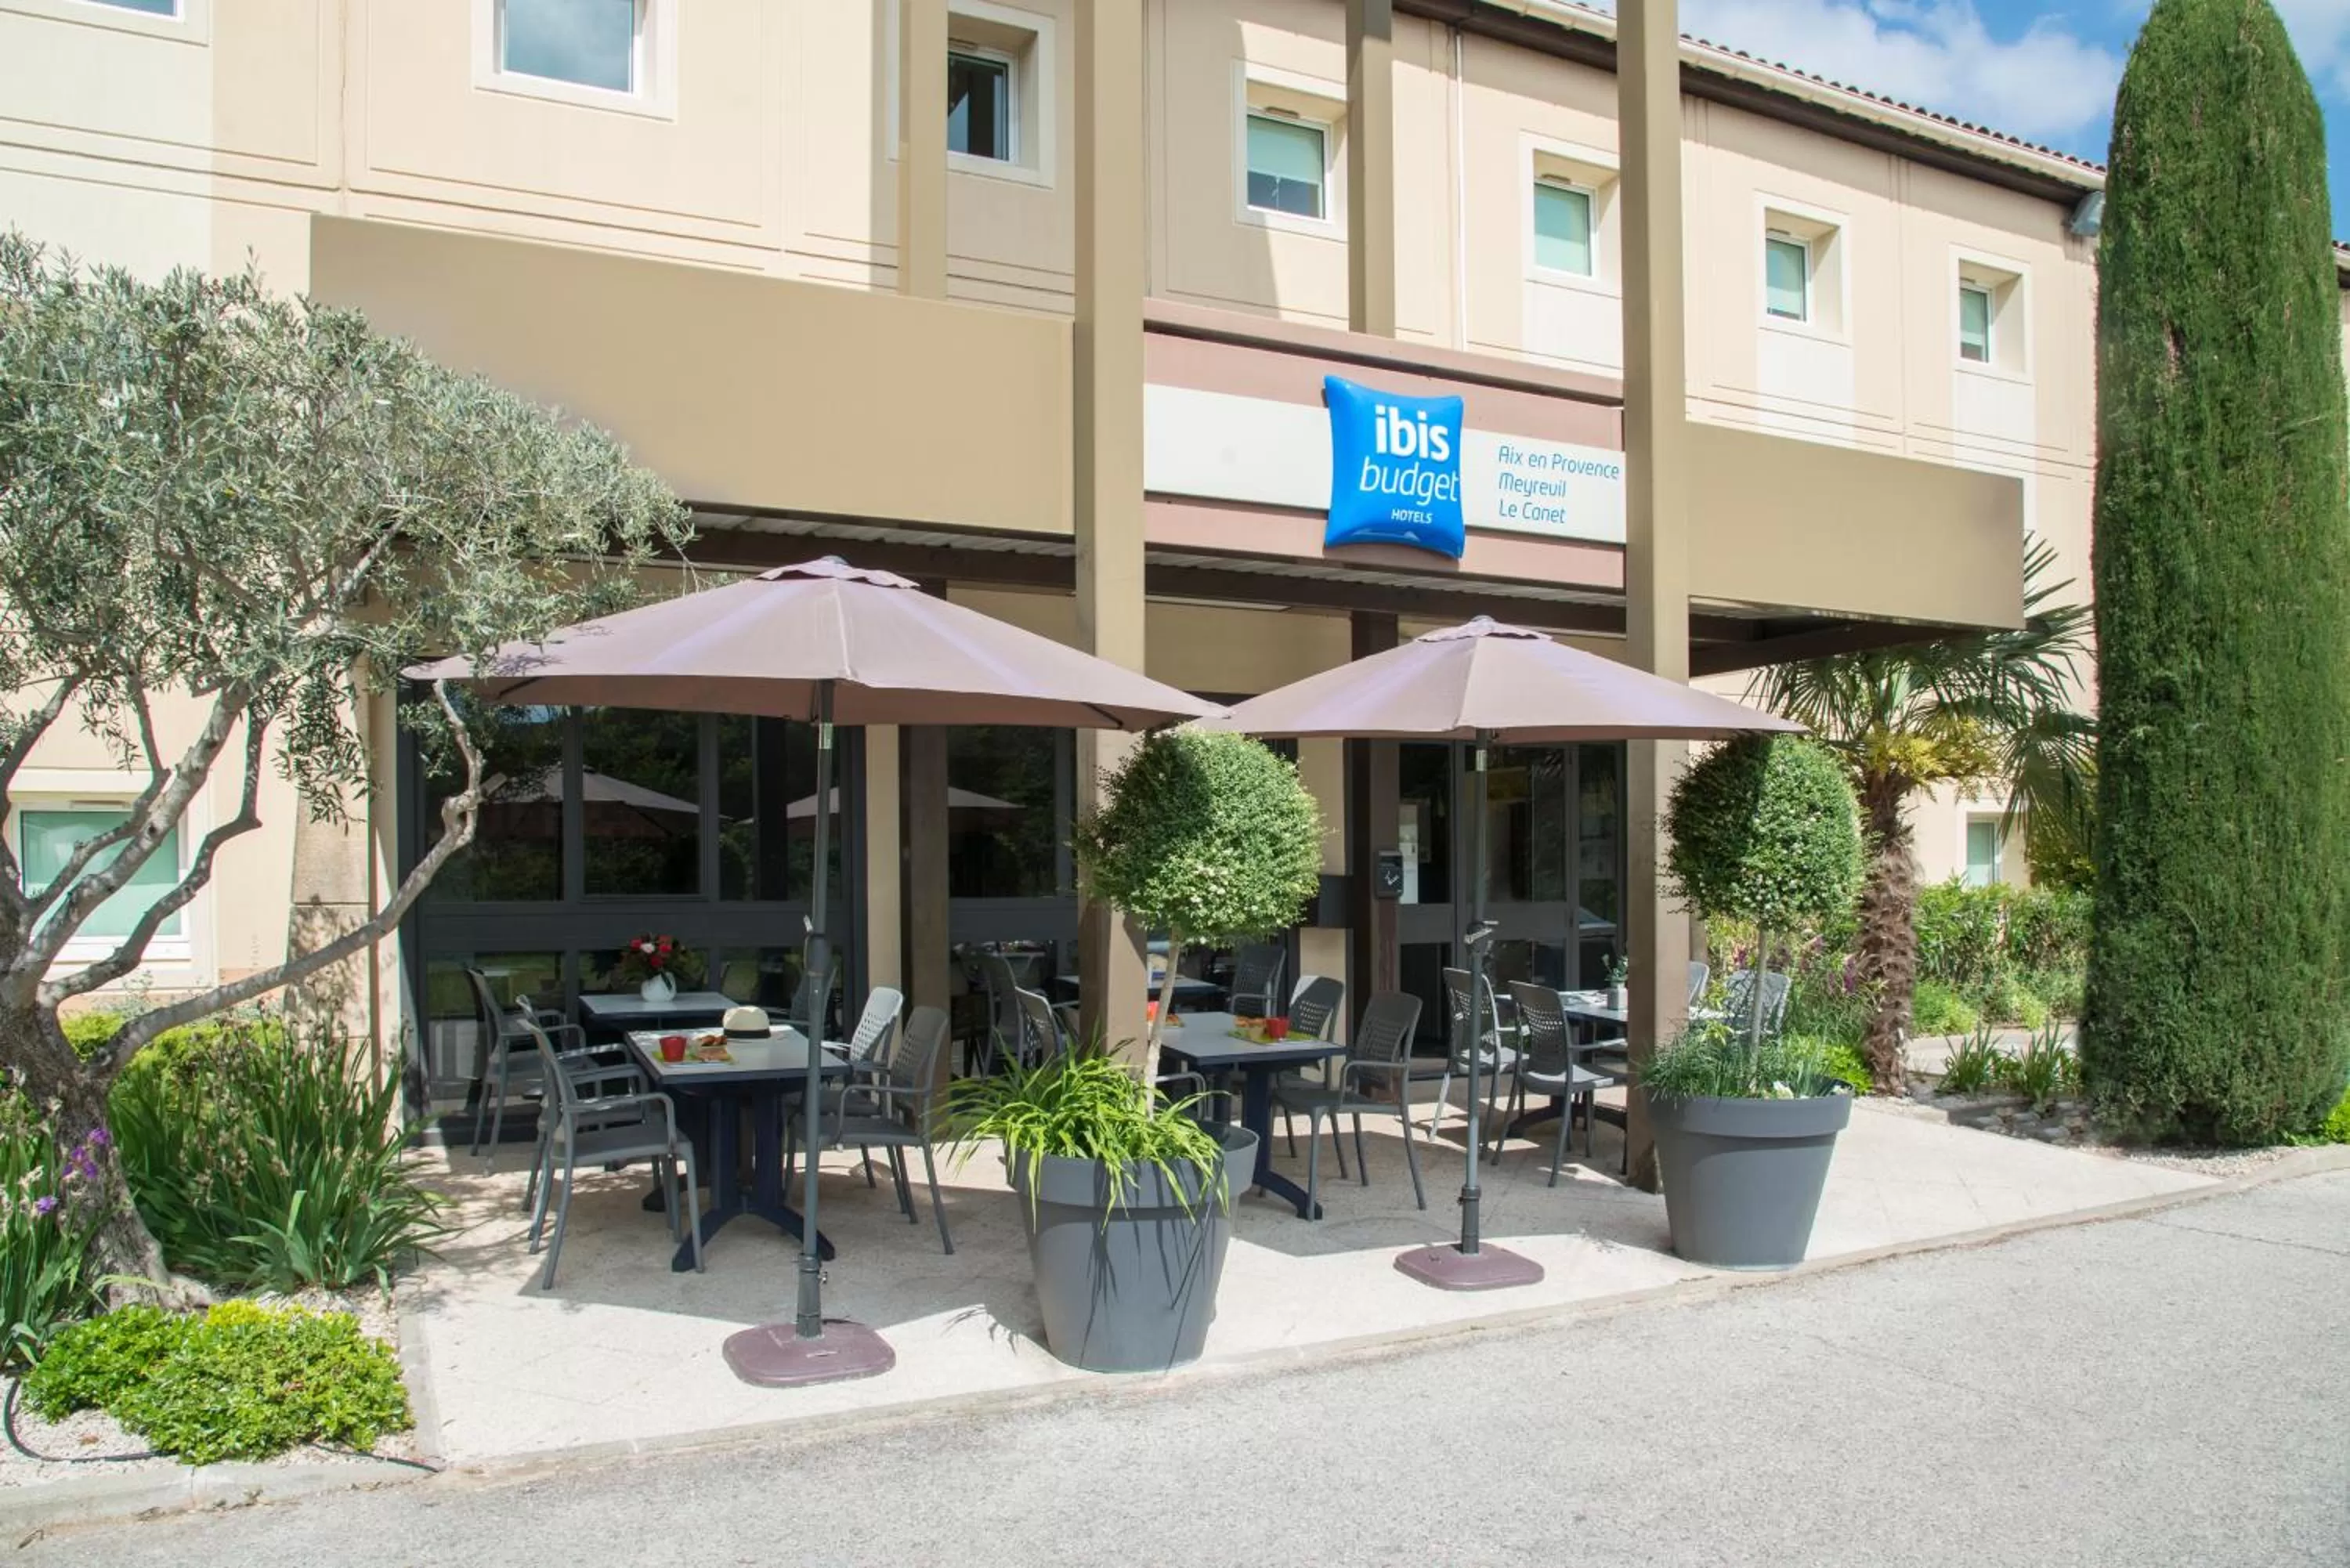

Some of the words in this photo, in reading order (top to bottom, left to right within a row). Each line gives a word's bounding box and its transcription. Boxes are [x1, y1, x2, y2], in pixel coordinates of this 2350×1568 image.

[1376, 404, 1450, 461] ibis
[1499, 445, 1523, 465] Aix
[1528, 453, 1547, 469] en
[1552, 453, 1619, 479] Provence
[1359, 455, 1459, 506] budget
[1499, 472, 1567, 497] Meyreuil
[1391, 508, 1433, 524] HOTELS
[1499, 499, 1517, 518] Le
